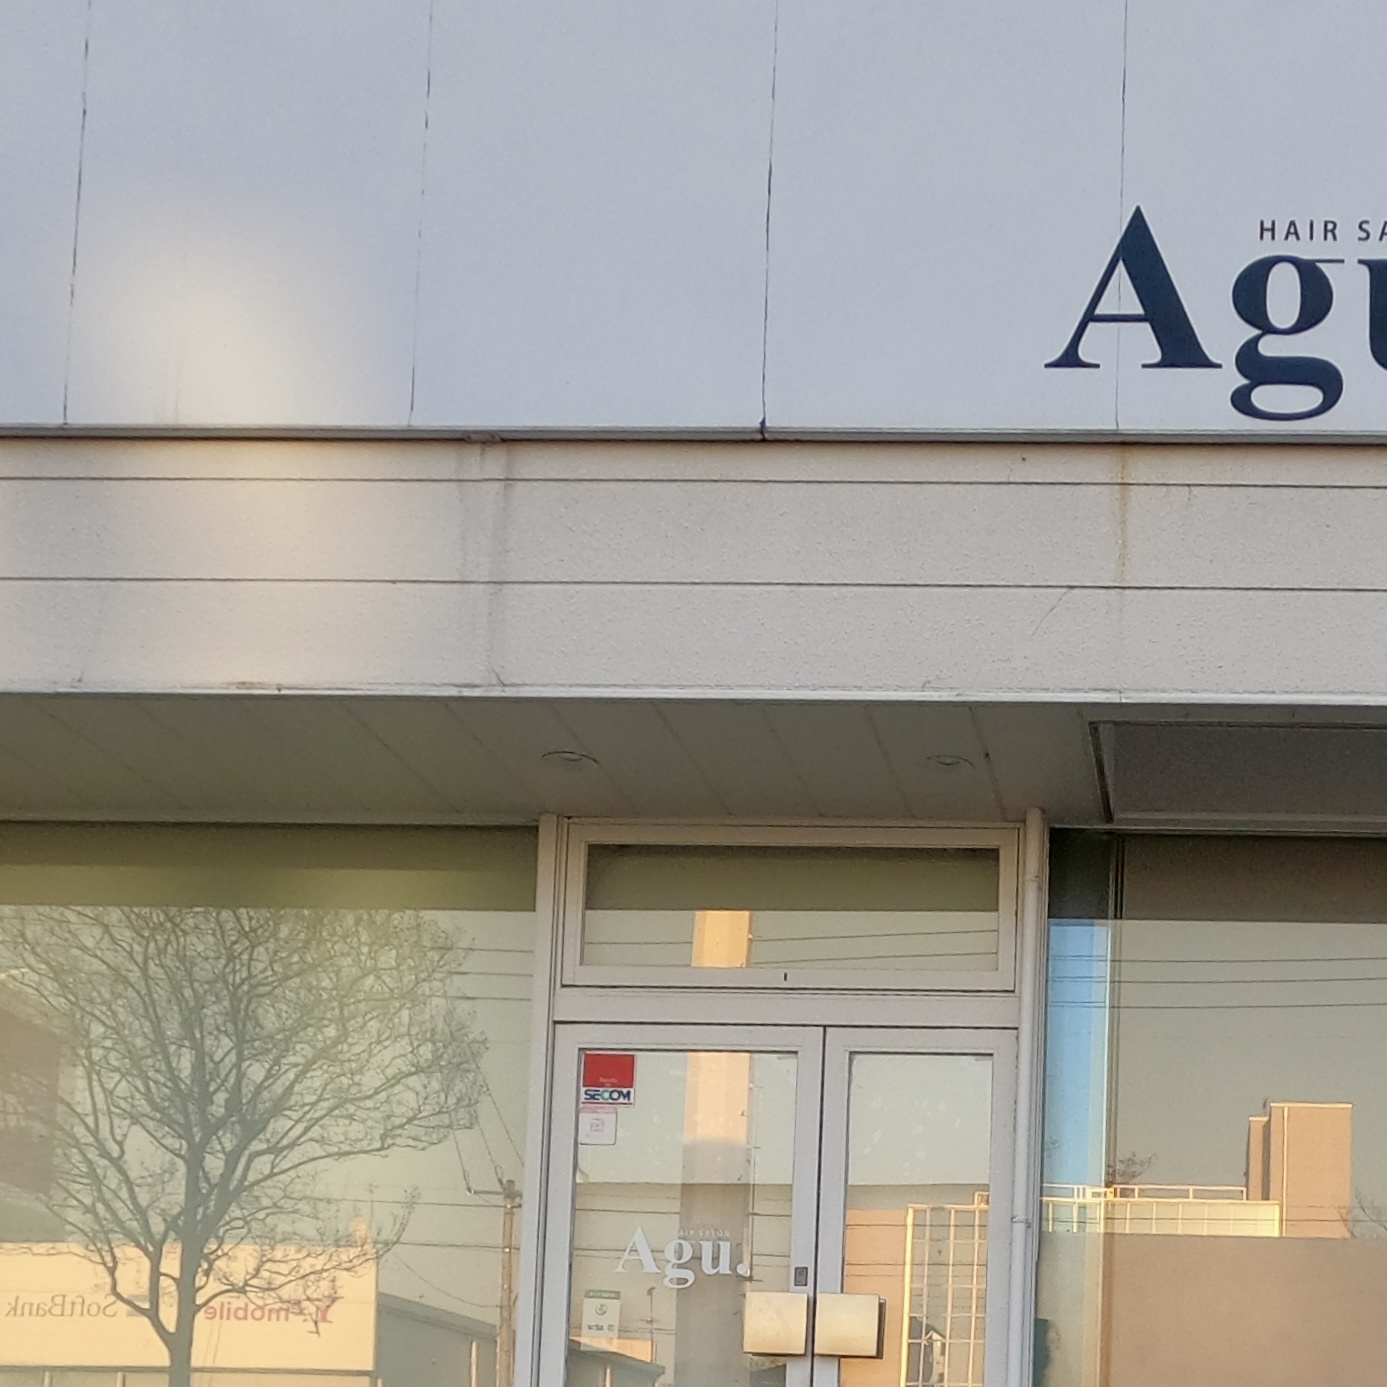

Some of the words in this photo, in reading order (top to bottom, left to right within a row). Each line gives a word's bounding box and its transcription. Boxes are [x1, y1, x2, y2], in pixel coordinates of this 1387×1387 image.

[1260, 219, 1338, 242] HAIR
[584, 1088, 631, 1101] SECOM
[614, 1226, 753, 1289] Agu.
